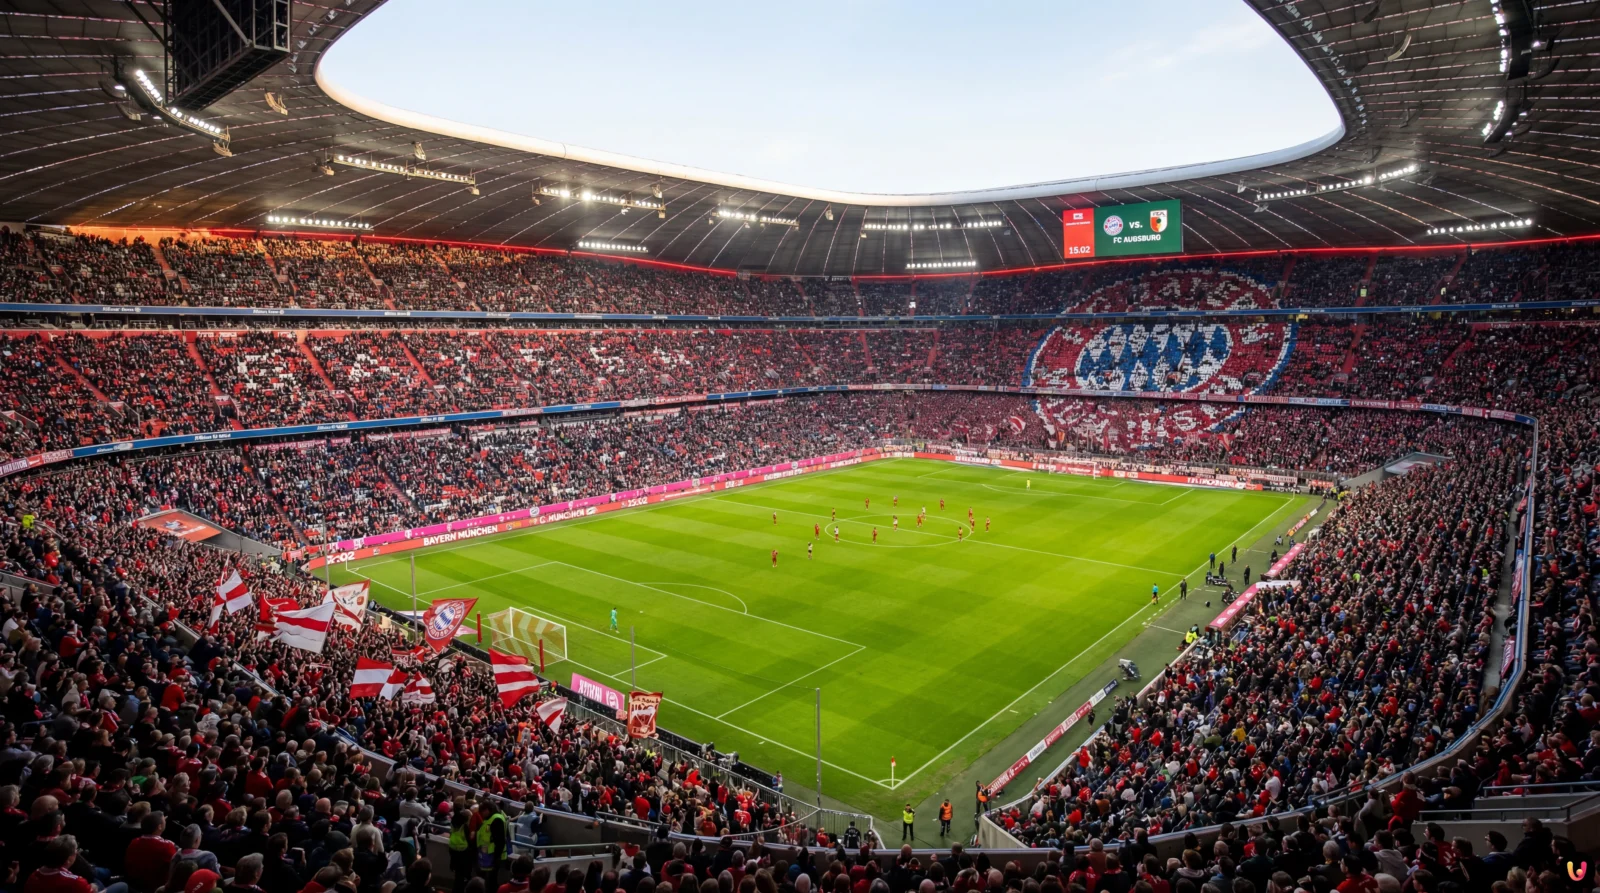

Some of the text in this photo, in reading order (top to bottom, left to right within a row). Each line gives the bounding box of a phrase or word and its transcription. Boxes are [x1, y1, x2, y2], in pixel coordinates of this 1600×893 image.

[1113, 236, 1122, 244] FC
[1069, 246, 1091, 255] 15.02
[423, 524, 498, 546] BAYERN MÜNCHEN
